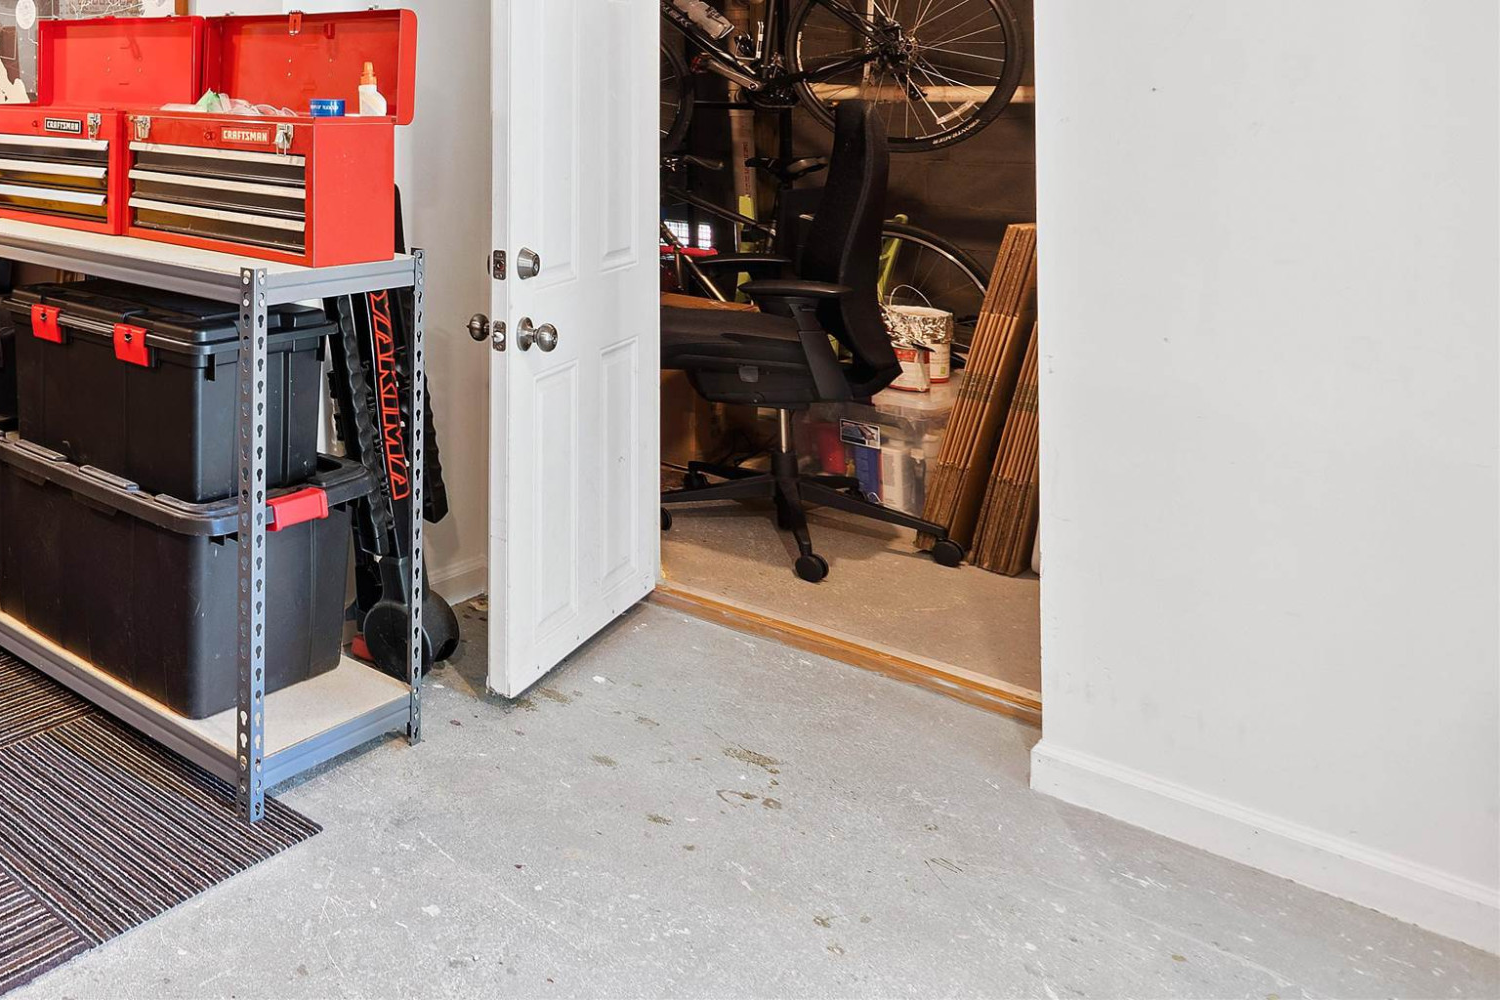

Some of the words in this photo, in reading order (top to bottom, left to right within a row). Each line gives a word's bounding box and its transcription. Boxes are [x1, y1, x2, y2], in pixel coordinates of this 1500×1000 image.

[46, 120, 79, 130] CRAFTSMAN
[222, 130, 268, 142] CRAFTSMAN
[369, 288, 410, 501] YAKIMA
